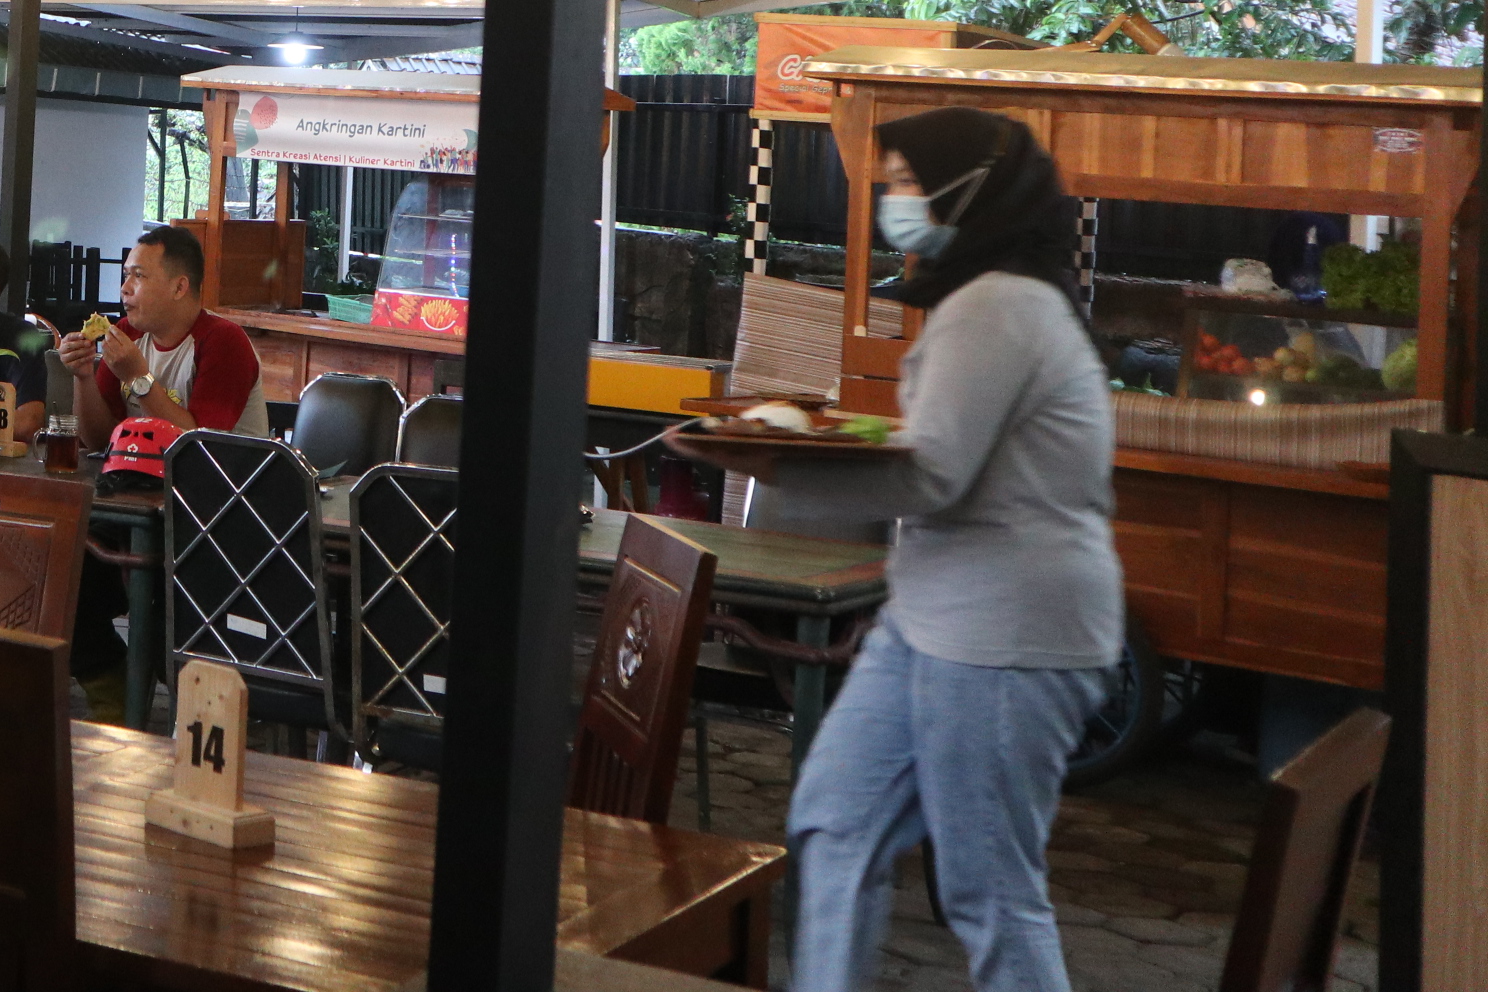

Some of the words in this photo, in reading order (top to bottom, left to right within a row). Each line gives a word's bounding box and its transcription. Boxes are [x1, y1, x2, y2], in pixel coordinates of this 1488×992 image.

[296, 118, 373, 138] Angkringan
[377, 122, 426, 139] Kartini
[250, 148, 281, 158] Sentra
[282, 150, 311, 161] Kreasi
[313, 152, 342, 163] Atensi
[349, 155, 381, 166] Kuliner
[384, 157, 416, 168] Kartini
[186, 720, 226, 775] 14
